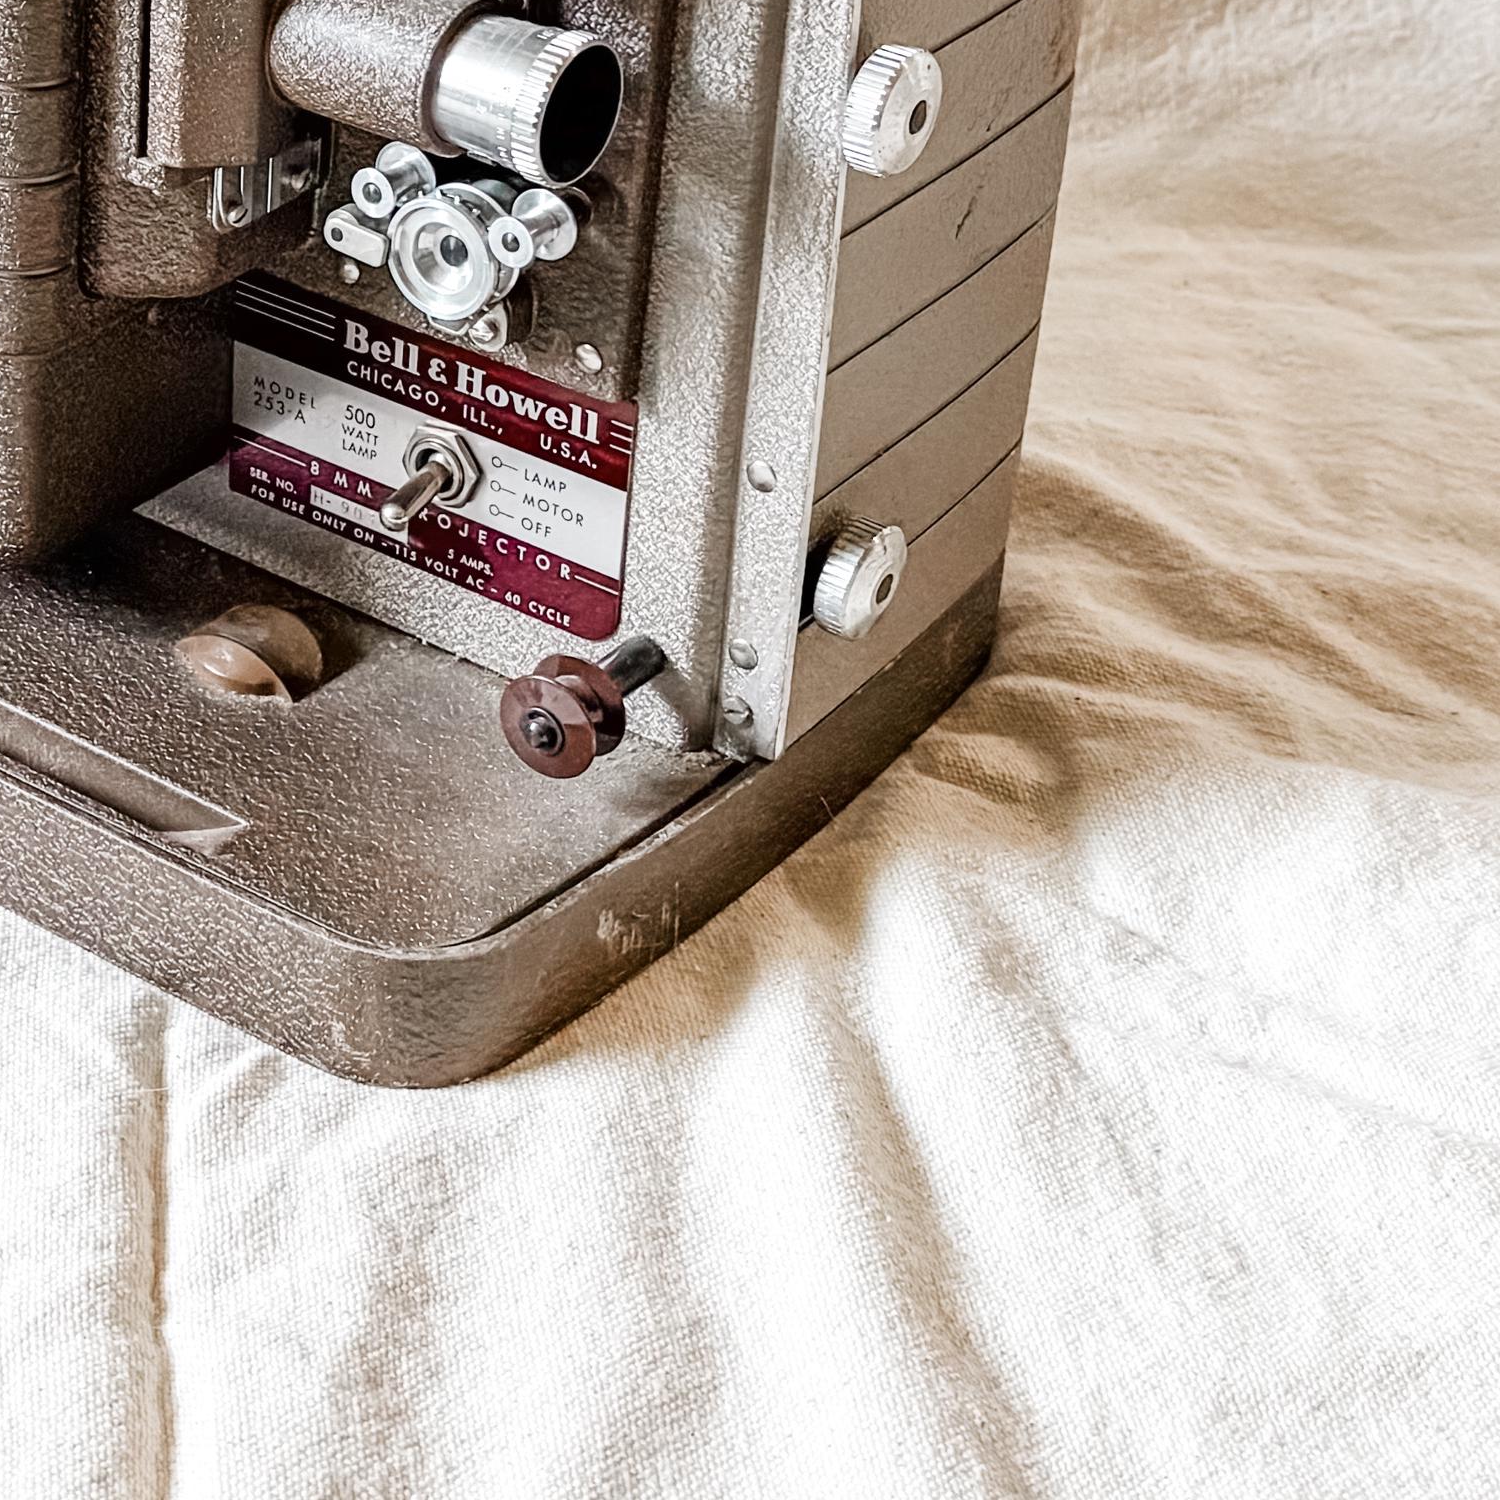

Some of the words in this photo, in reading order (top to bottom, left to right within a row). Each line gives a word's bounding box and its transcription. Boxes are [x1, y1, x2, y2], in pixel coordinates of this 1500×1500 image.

[253, 375, 317, 410] MODEL
[344, 319, 421, 376] Bell
[427, 358, 448, 385] &
[454, 361, 600, 444] Howell
[253, 391, 306, 424] 253-A
[344, 404, 376, 429] 500
[347, 361, 447, 413] CHICAGO,
[462, 404, 504, 435] ILL.,
[540, 433, 598, 469] U.S.A.
[341, 423, 379, 447] WATT
[342, 438, 378, 460] LAMP
[250, 466, 271, 484] SER.
[275, 477, 297, 494] NO.
[524, 469, 567, 493] LAMP
[310, 460, 320, 476] 8
[418, 507, 572, 580] ROJECTOR
[522, 493, 584, 527] MOTOR
[521, 517, 552, 538] OFF
[251, 484, 276, 502] FOR
[282, 498, 306, 515] USE
[312, 511, 347, 532] ONLY
[353, 528, 374, 544] ON
[424, 556, 459, 579] VOLT
[466, 575, 485, 590] AC
[504, 591, 521, 605] 60
[528, 601, 571, 627] CYCLE
[460, 554, 494, 577] AMPS.
